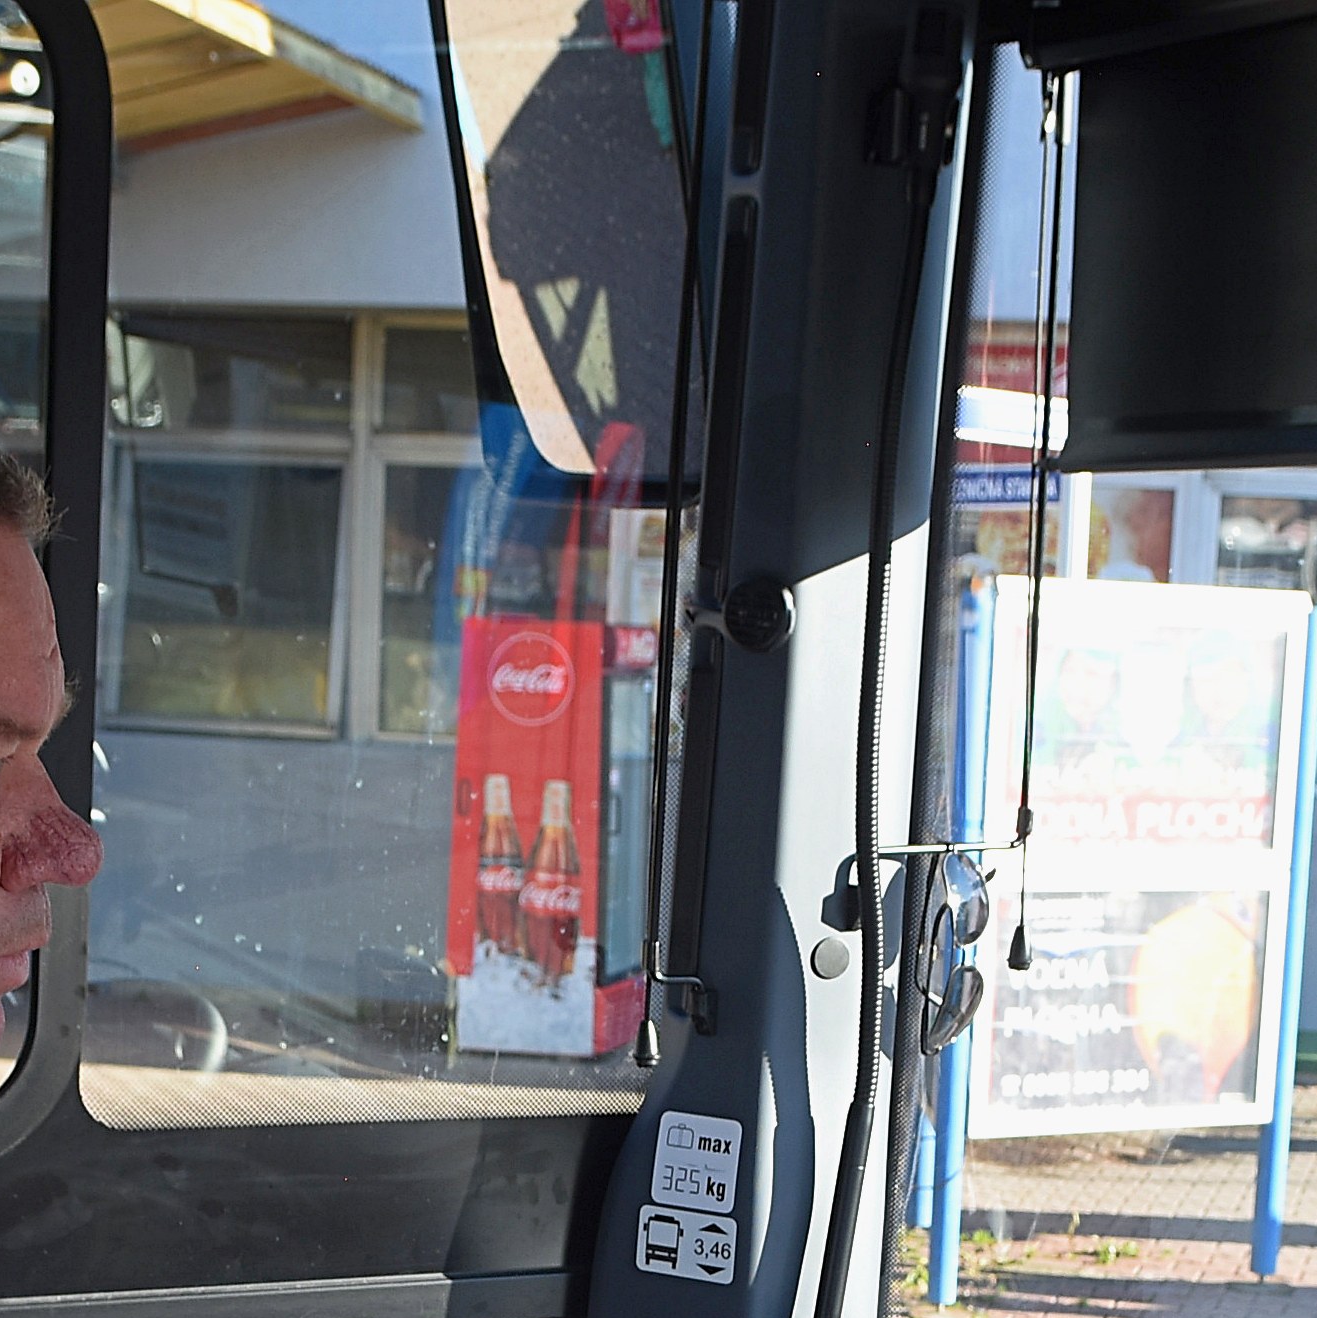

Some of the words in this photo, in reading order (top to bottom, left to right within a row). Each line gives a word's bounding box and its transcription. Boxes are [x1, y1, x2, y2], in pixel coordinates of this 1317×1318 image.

[697, 1136, 732, 1155] max
[662, 1165, 701, 1195] 325
[705, 1176, 726, 1202] kg
[693, 1238, 732, 1260] 3,46
